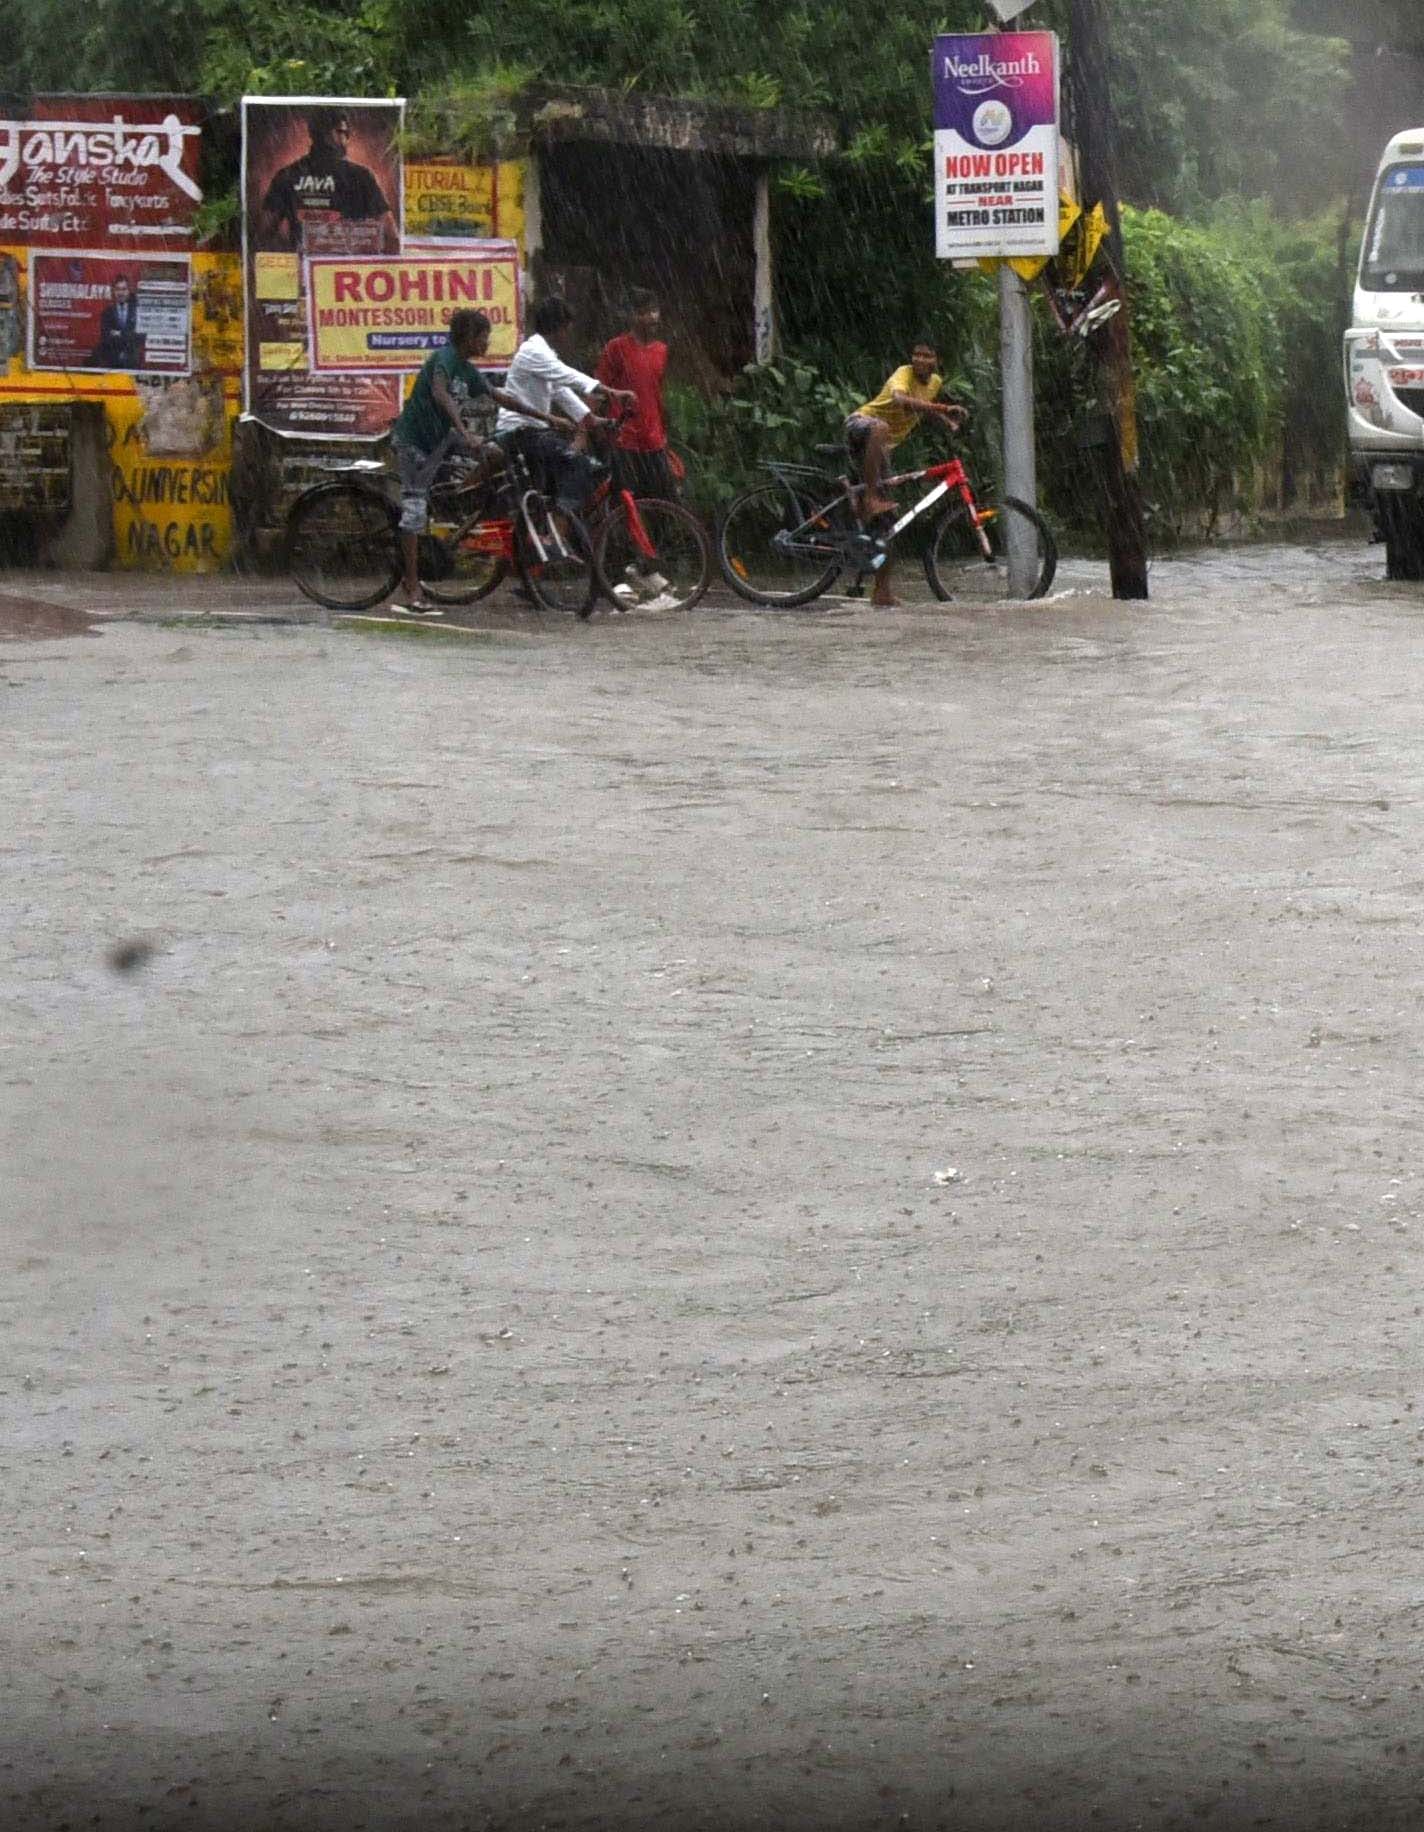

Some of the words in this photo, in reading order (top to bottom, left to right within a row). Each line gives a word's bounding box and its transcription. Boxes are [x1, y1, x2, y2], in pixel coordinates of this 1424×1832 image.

[943, 52, 1041, 85] Neelkanth
[946, 155, 992, 179] NOW
[995, 152, 1044, 177] OPEN
[55, 167, 96, 186] Style
[98, 168, 149, 186] Studio
[294, 175, 336, 192] JAVA
[959, 181, 1011, 194] TRANSPORT
[1013, 180, 1044, 192] NAGAR
[978, 195, 1013, 207] NEAR
[946, 209, 990, 227] METRO
[992, 206, 1045, 225] STATION
[333, 268, 494, 303] ROHINI
[319, 308, 434, 327] MONTESSORI
[371, 334, 427, 347] Nursery
[432, 334, 447, 346] to
[128, 521, 219, 557] NAGAR
